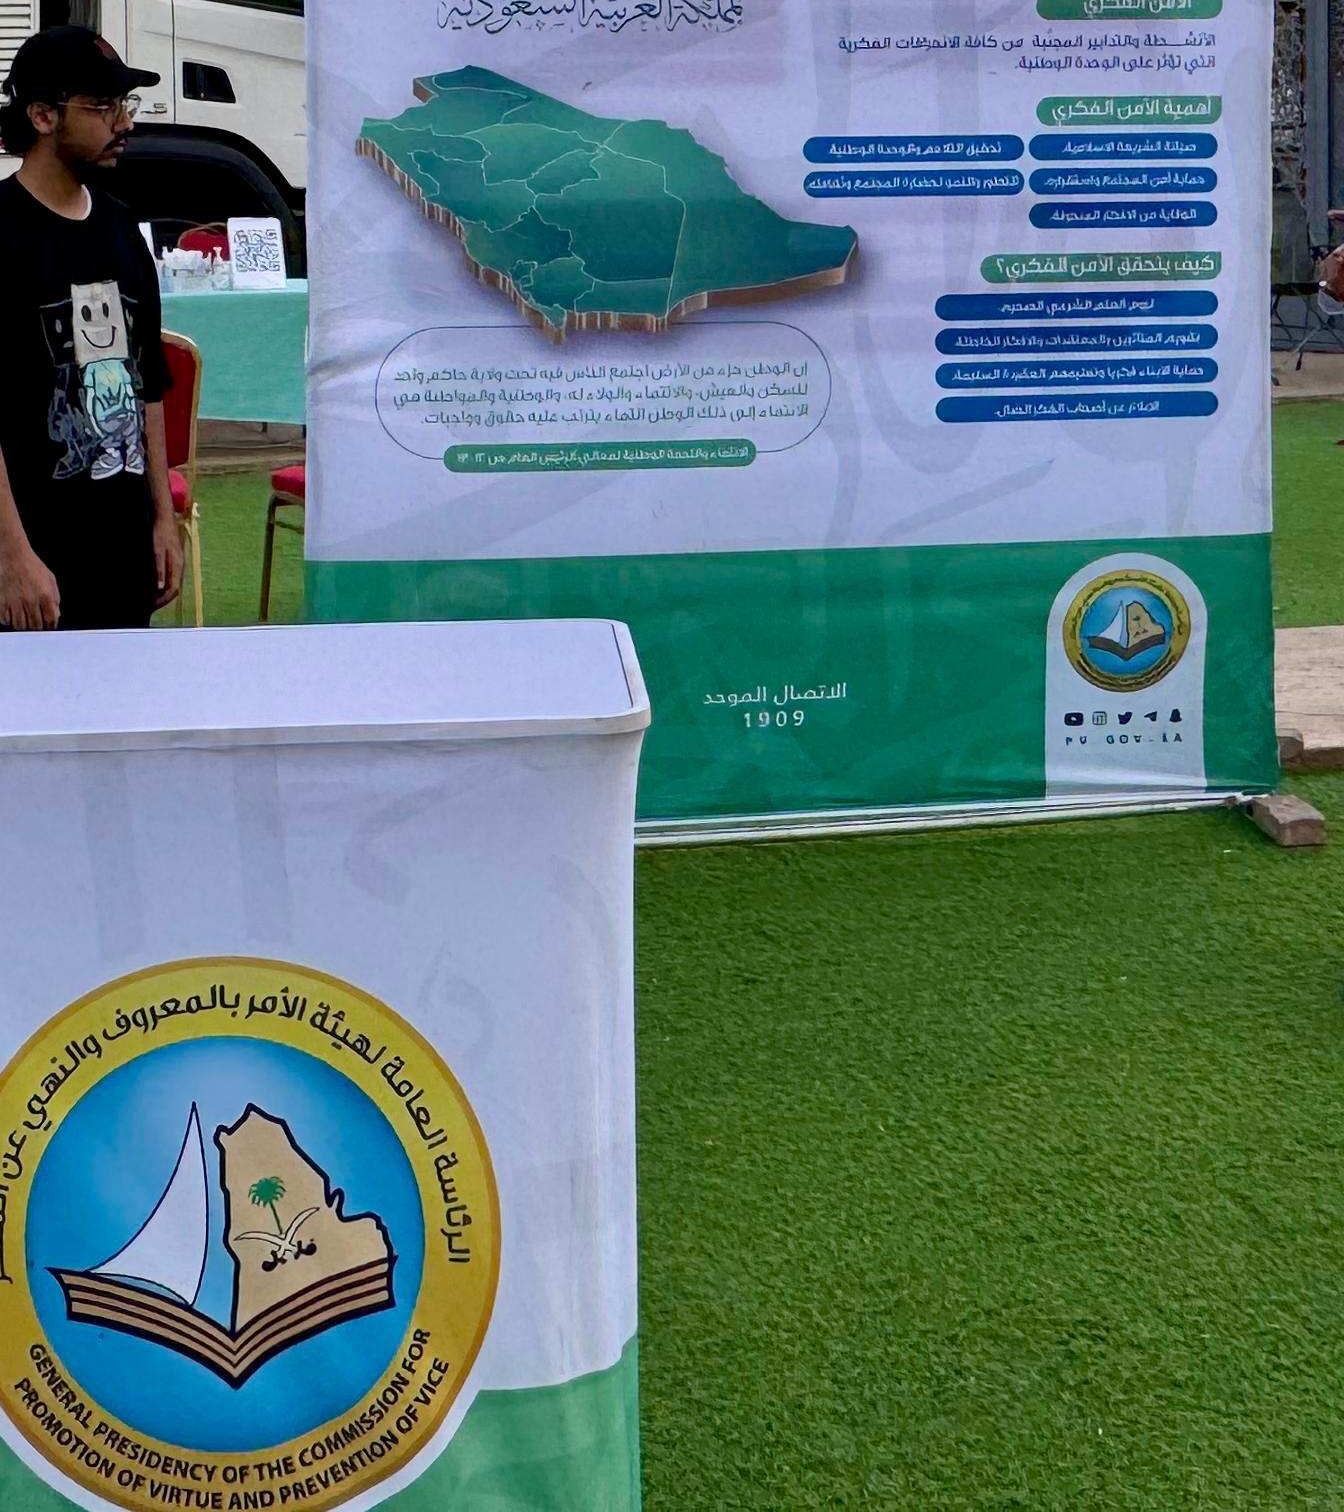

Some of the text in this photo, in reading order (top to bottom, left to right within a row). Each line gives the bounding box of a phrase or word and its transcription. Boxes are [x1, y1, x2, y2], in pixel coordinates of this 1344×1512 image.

[703, 681, 847, 707] الاتصال الموحد
[743, 710, 805, 728] 1909
[101, 983, 241, 1041] بالمعروف
[244, 985, 307, 1021] الأمر
[309, 1001, 387, 1065] لهيئة
[22, 1034, 104, 1131] والنهي
[380, 1055, 448, 1150] العامة
[2, 1129, 27, 1181] عن
[433, 1151, 472, 1264] الرئاسة
[14, 1356, 451, 1512] PROMOTION OF VIRTUE AND PREVENTION OF VICE
[29, 1327, 432, 1486] GENERAL PRESIDENCY OF THE COMMISSION FOR
